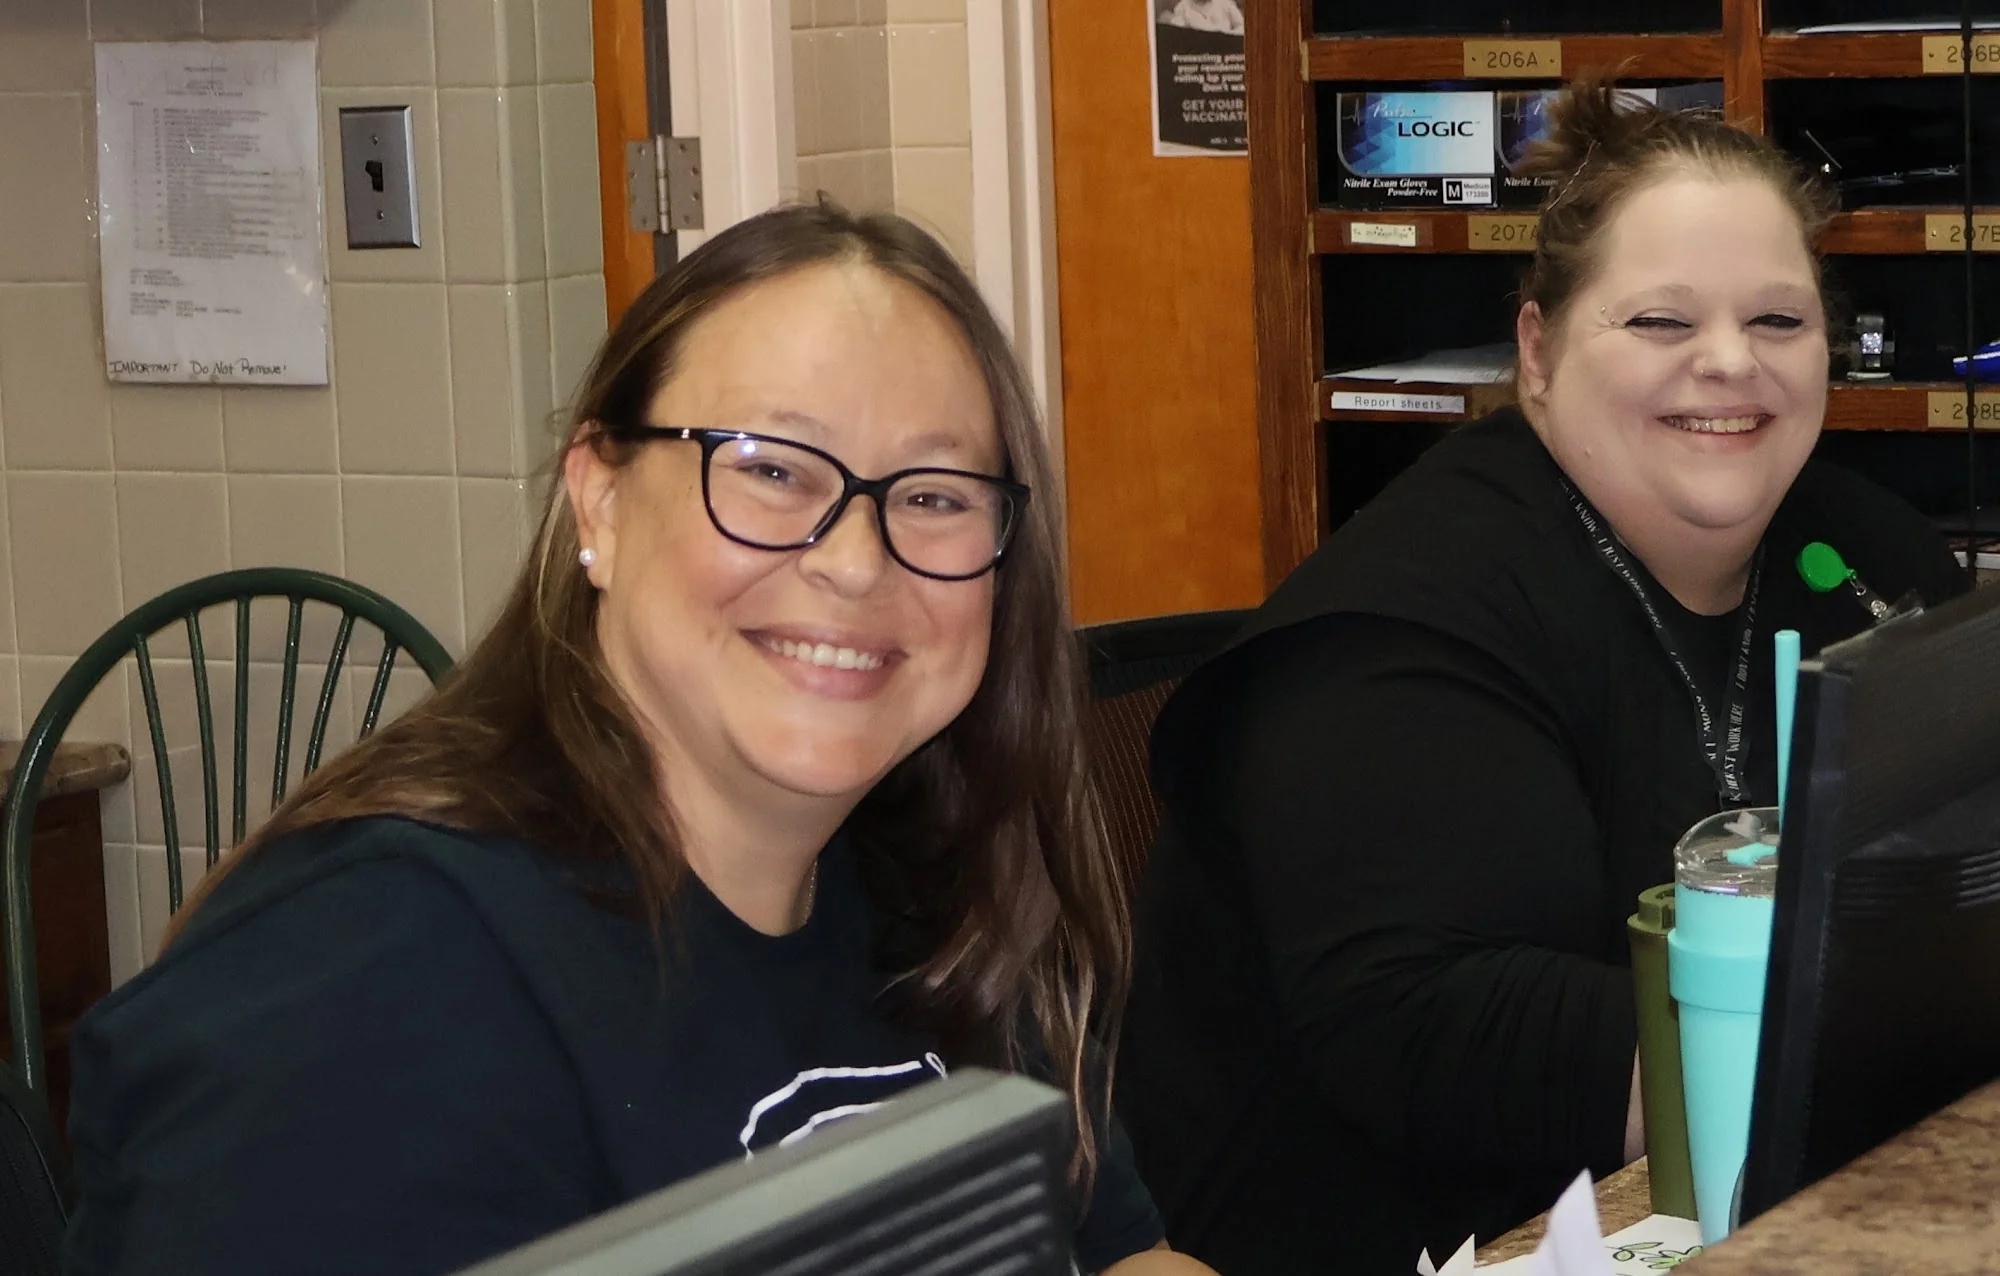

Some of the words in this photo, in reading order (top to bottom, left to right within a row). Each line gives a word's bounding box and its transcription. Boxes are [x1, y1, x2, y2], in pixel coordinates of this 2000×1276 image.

[1486, 51, 1539, 69] 206A
[1181, 99, 1205, 111] GET
[1208, 99, 1244, 111] YOUR
[1398, 121, 1474, 137] LOGIC
[1343, 178, 1372, 188] Nitrile
[1373, 178, 1398, 188] Exam
[1400, 178, 1428, 189] Gloves
[1503, 177, 1532, 187] Nitrile
[1387, 187, 1438, 197] Powder-Free
[1448, 184, 1461, 198] M
[109, 360, 179, 374] IMPORTANT
[190, 360, 209, 375] Do
[212, 361, 234, 375] Not
[1354, 395, 1396, 408] Report
[1400, 399, 1443, 410] sheets
